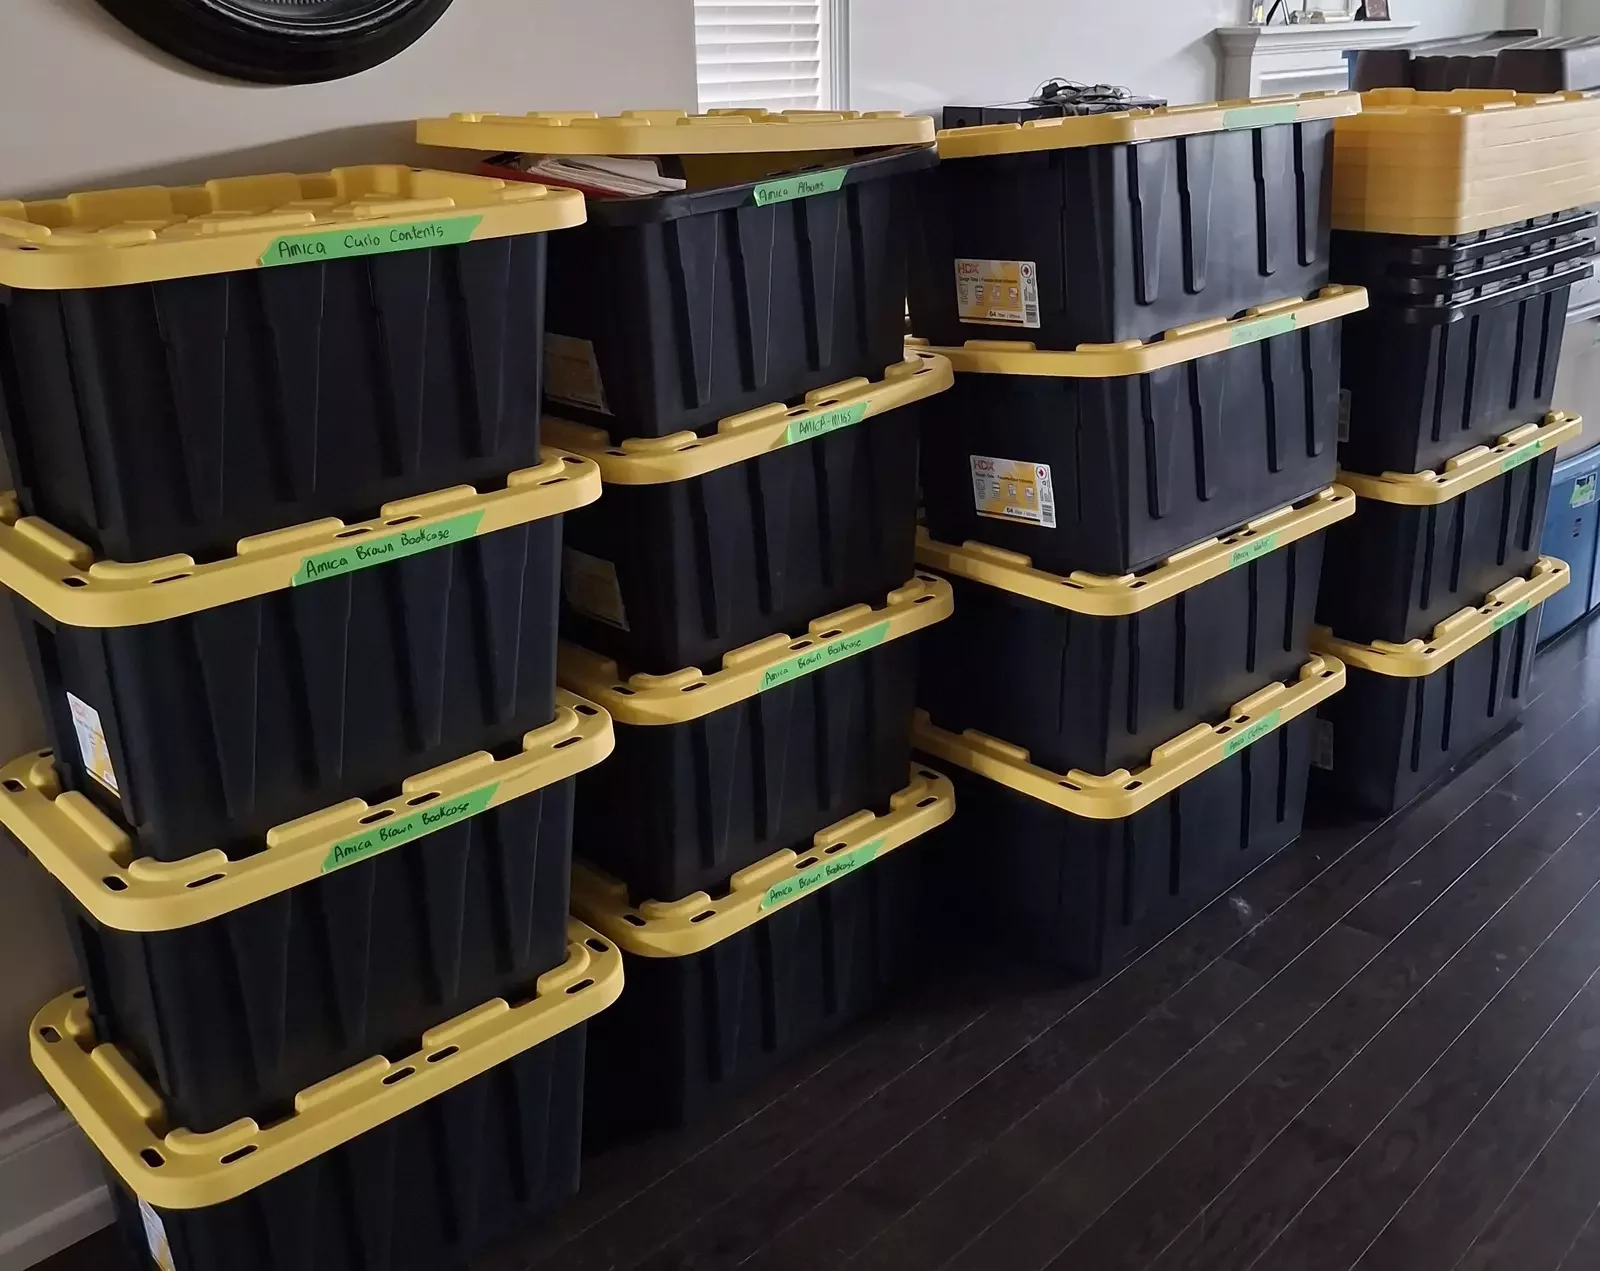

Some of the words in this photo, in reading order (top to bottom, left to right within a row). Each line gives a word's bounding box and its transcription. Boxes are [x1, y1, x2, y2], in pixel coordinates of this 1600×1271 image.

[758, 188, 788, 202] Amica
[797, 181, 824, 194] Albums
[278, 240, 327, 259] Amica
[343, 233, 380, 249] Curio
[389, 223, 444, 243] Contents
[957, 263, 980, 275] HDX
[973, 460, 995, 472] HDX
[306, 556, 349, 578] Amica
[355, 542, 395, 560] Brown
[400, 528, 450, 547] Bookcase
[764, 668, 789, 685] Amica
[796, 652, 822, 669] Brown
[827, 639, 862, 656] Bookcase
[333, 839, 373, 863] Amica
[379, 823, 414, 842] Brown
[421, 802, 470, 825] Bookcase
[769, 886, 793, 903] Amica
[798, 873, 821, 890] Brown
[825, 859, 855, 876] Bookcase
